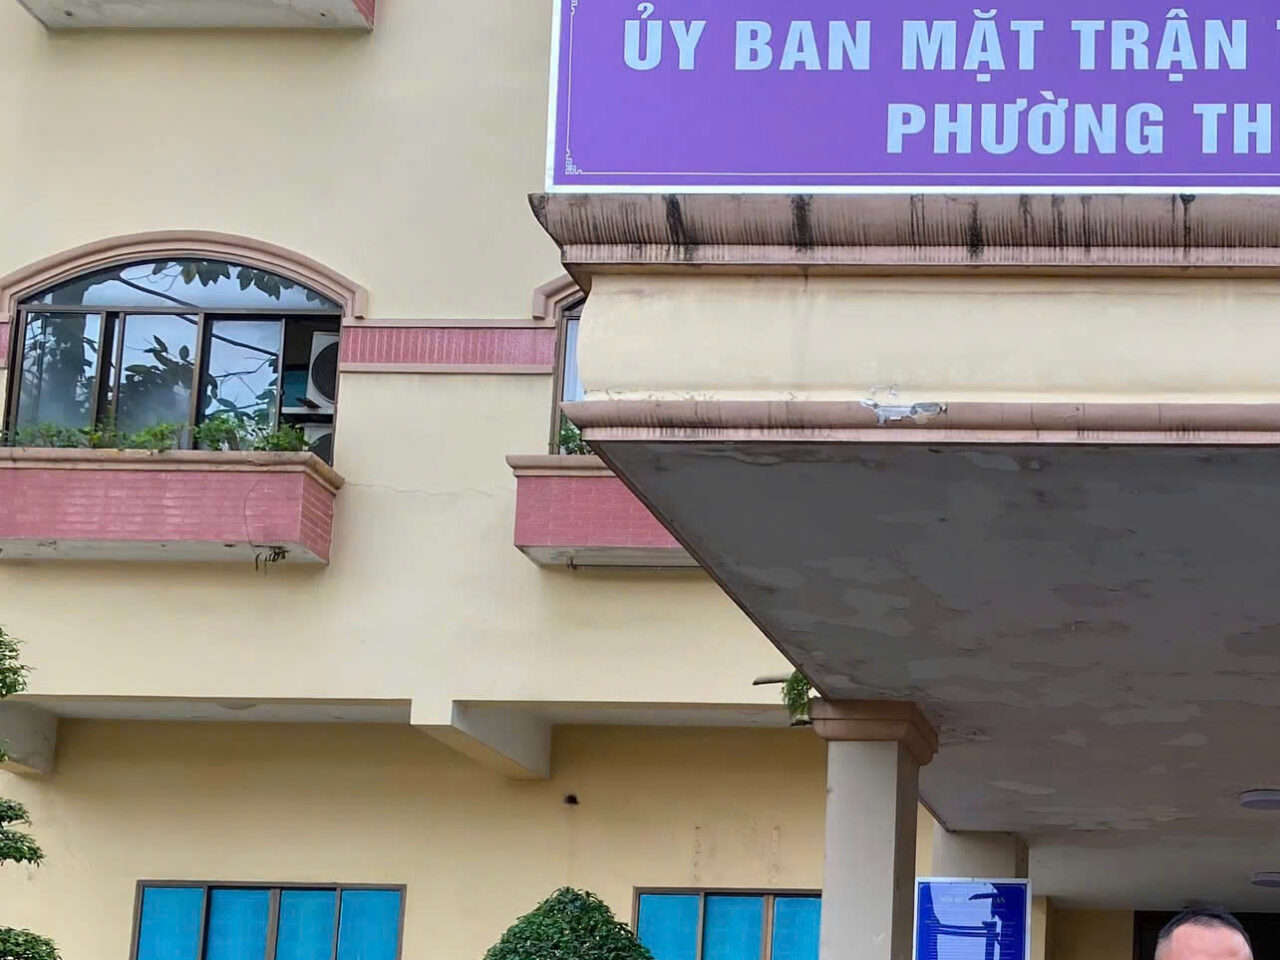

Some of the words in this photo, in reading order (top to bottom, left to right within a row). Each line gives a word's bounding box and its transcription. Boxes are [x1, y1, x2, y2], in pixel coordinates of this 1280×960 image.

[624, 2, 706, 70] ỦY
[735, 21, 870, 71] BAN
[902, 9, 1044, 82] MẶT
[1071, 9, 1246, 82] TRẬN
[886, 91, 1165, 155] PHƯỜNG
